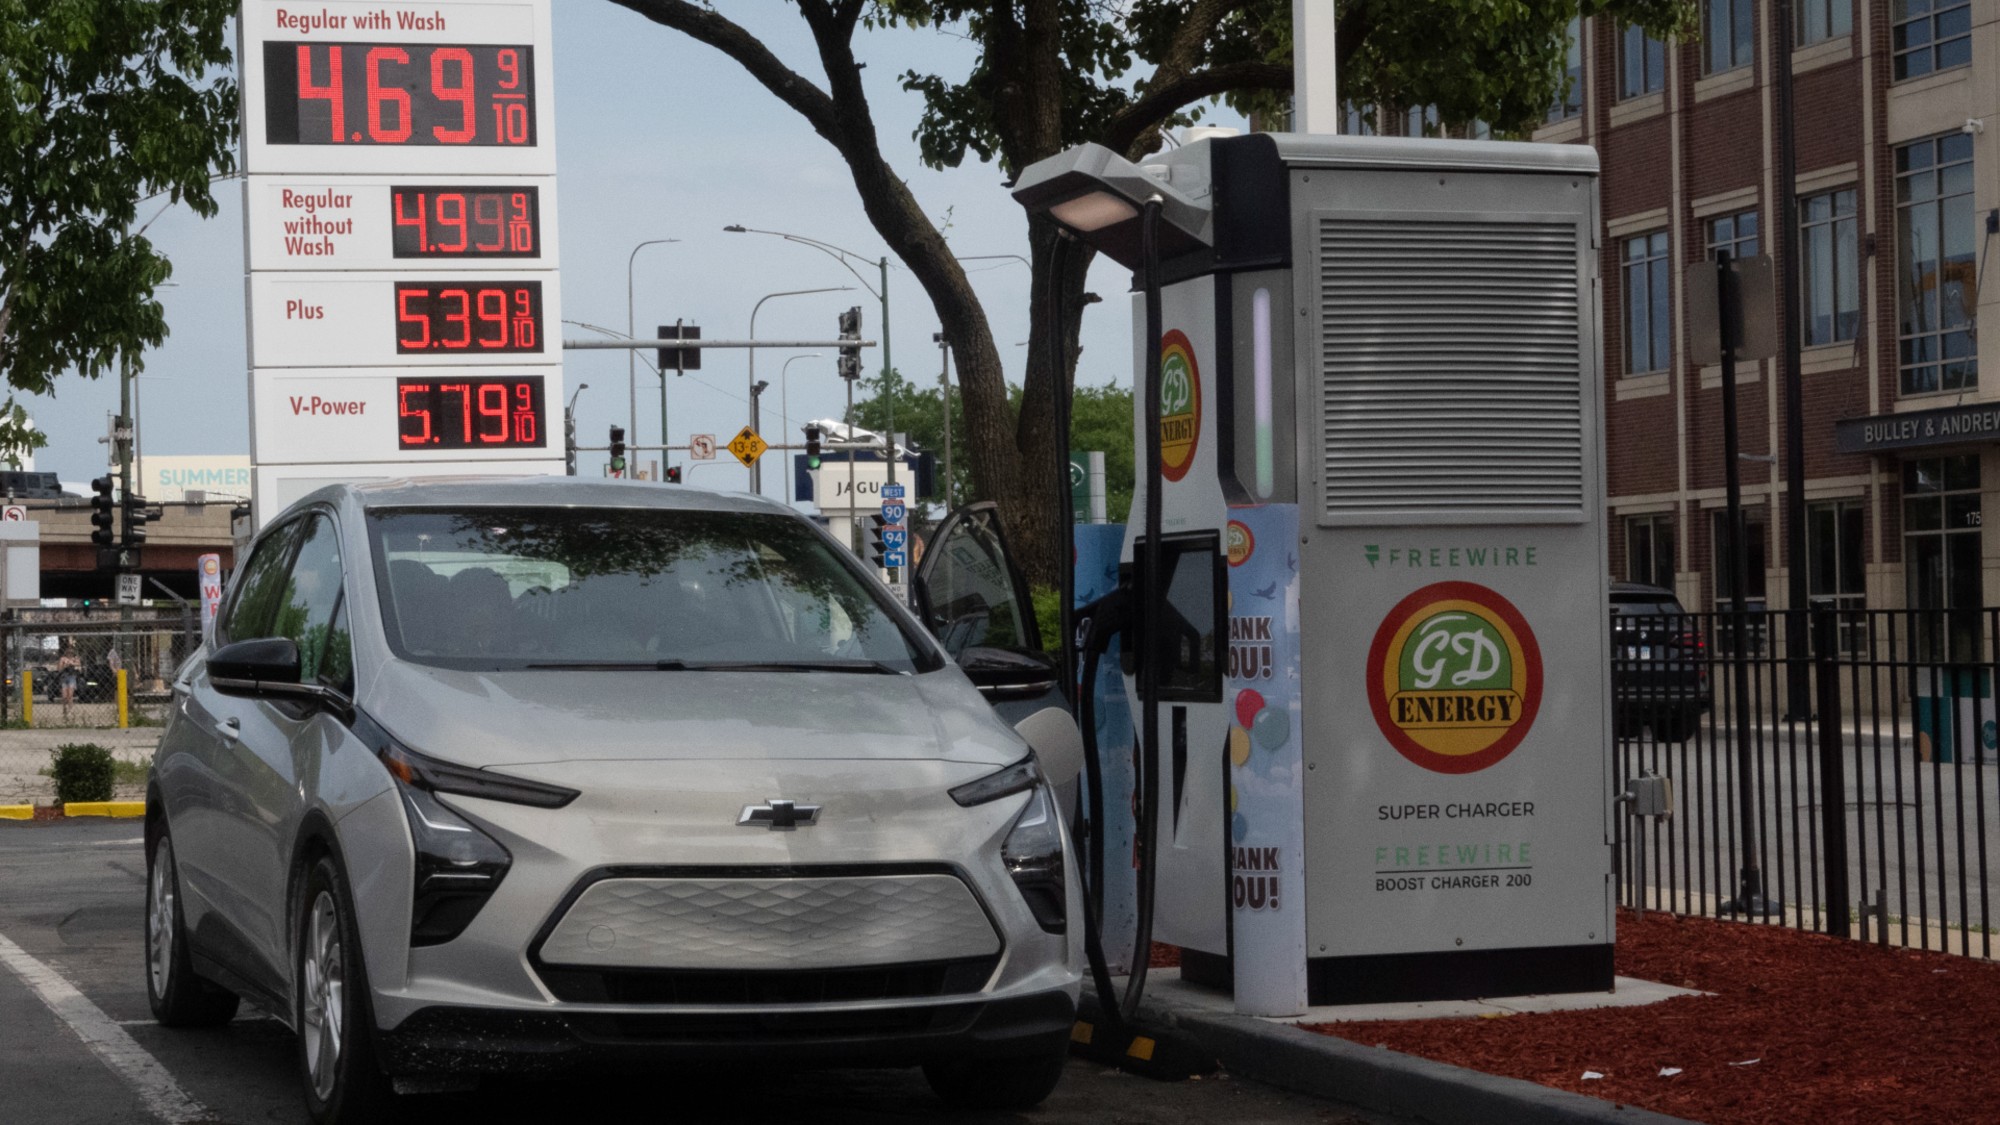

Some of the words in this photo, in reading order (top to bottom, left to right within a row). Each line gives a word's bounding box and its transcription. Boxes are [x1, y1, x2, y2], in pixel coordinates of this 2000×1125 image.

[277, 9, 347, 34] Regular
[353, 11, 391, 30] with
[397, 11, 446, 31] Wash
[297, 45, 476, 143] 4.69
[497, 48, 519, 89] 9
[492, 103, 527, 144] 10
[282, 188, 353, 213] Regular
[284, 214, 353, 235] without
[395, 193, 505, 252] 4.99
[511, 193, 527, 221] 9
[285, 236, 335, 256] Wash
[509, 224, 532, 252] 10
[286, 299, 324, 320] Plus
[400, 288, 508, 349] 5.39
[515, 289, 530, 318] 9
[513, 319, 536, 348] 10
[289, 396, 367, 416] V-Power
[400, 384, 510, 444] 5.79
[516, 383, 531, 412] 9
[513, 414, 536, 443] 10
[1161, 417, 1194, 442] NERGY
[1864, 420, 1920, 443] BULLEY
[1925, 418, 1935, 436] &
[159, 467, 250, 486] SUMMER
[836, 481, 901, 496] JAGU
[883, 488, 903, 497] WEST
[885, 506, 902, 519] 90
[886, 532, 904, 544] 94
[122, 577, 138, 585] ONE
[1228, 616, 1273, 641] ANK
[1229, 646, 1273, 680] OU!
[1397, 695, 1516, 723] ENERGY
[1378, 804, 1440, 821] SUPER
[1445, 802, 1535, 818] CHARGER
[1234, 874, 1279, 909] OU!
[1376, 877, 1426, 891] BOOST
[1431, 875, 1500, 890] CHARGER
[1506, 873, 1532, 888] 200
